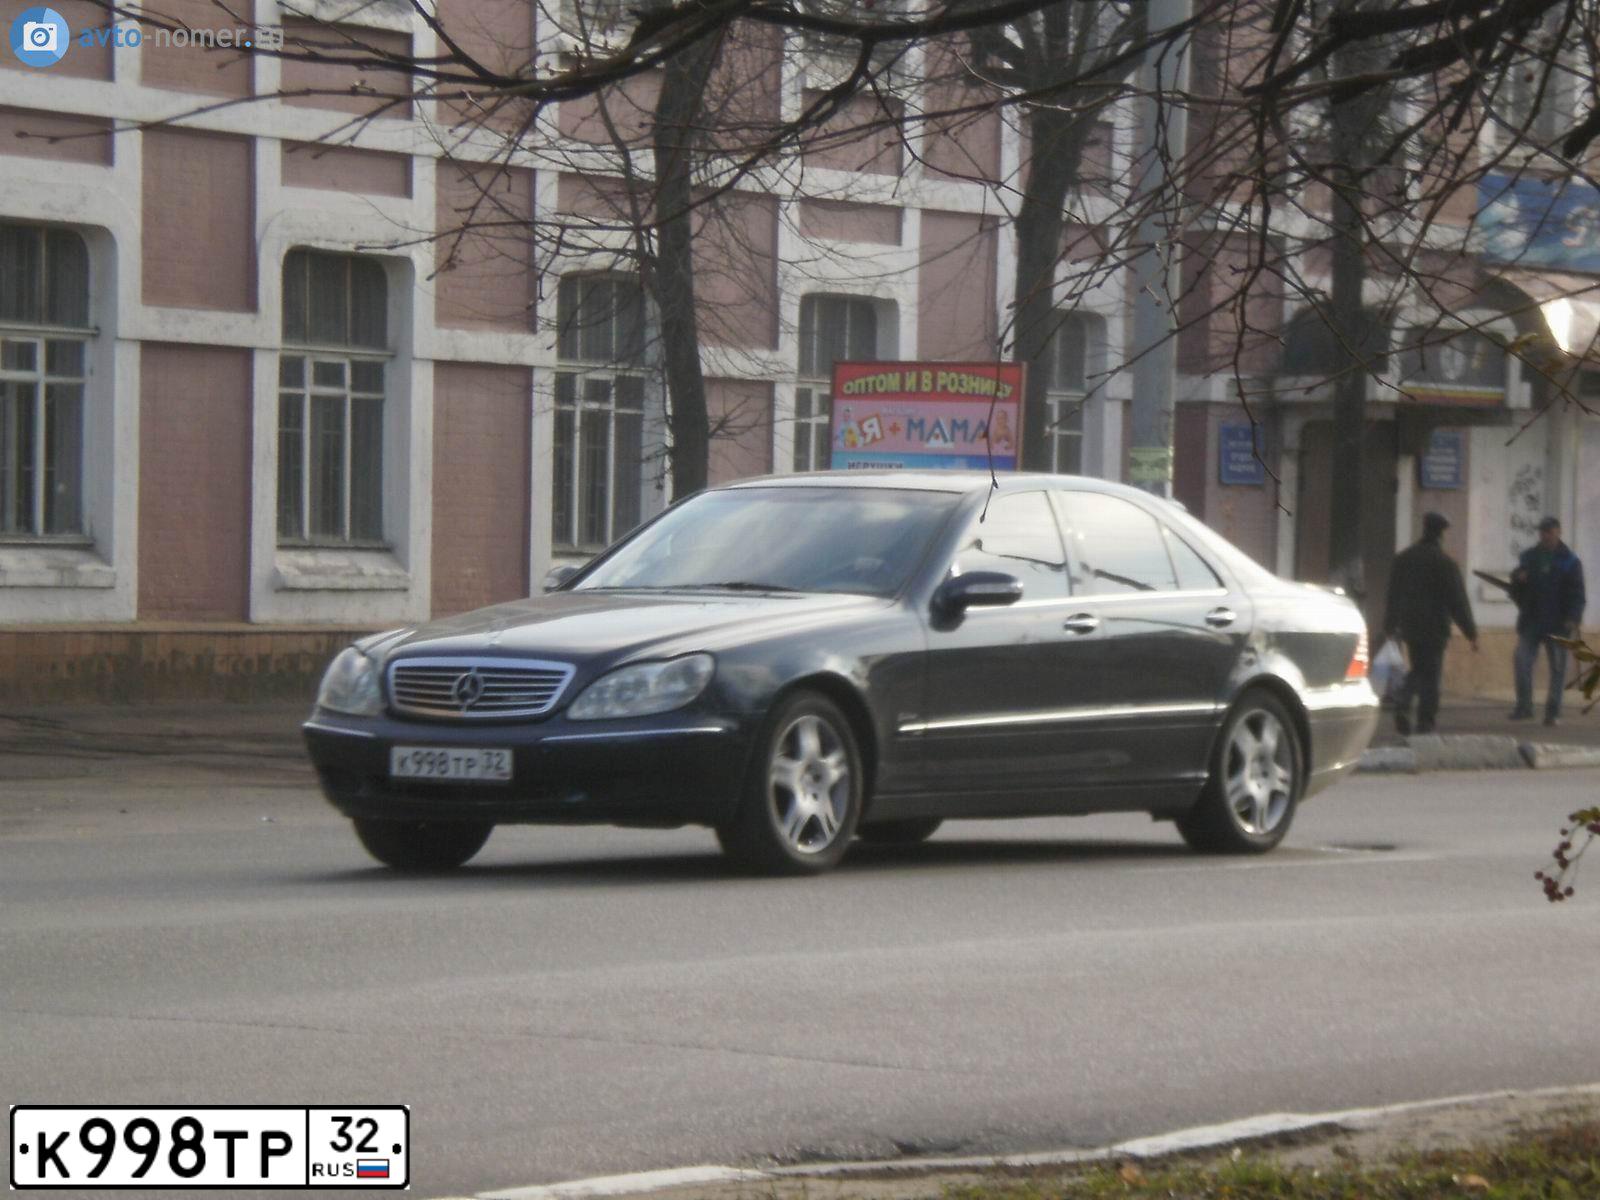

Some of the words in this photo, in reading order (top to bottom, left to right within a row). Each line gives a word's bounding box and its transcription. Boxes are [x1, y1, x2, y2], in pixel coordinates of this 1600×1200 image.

[843, 373, 900, 394] ОПТОМ
[905, 372, 917, 392] И
[921, 371, 933, 392] В
[862, 417, 881, 443] Я
